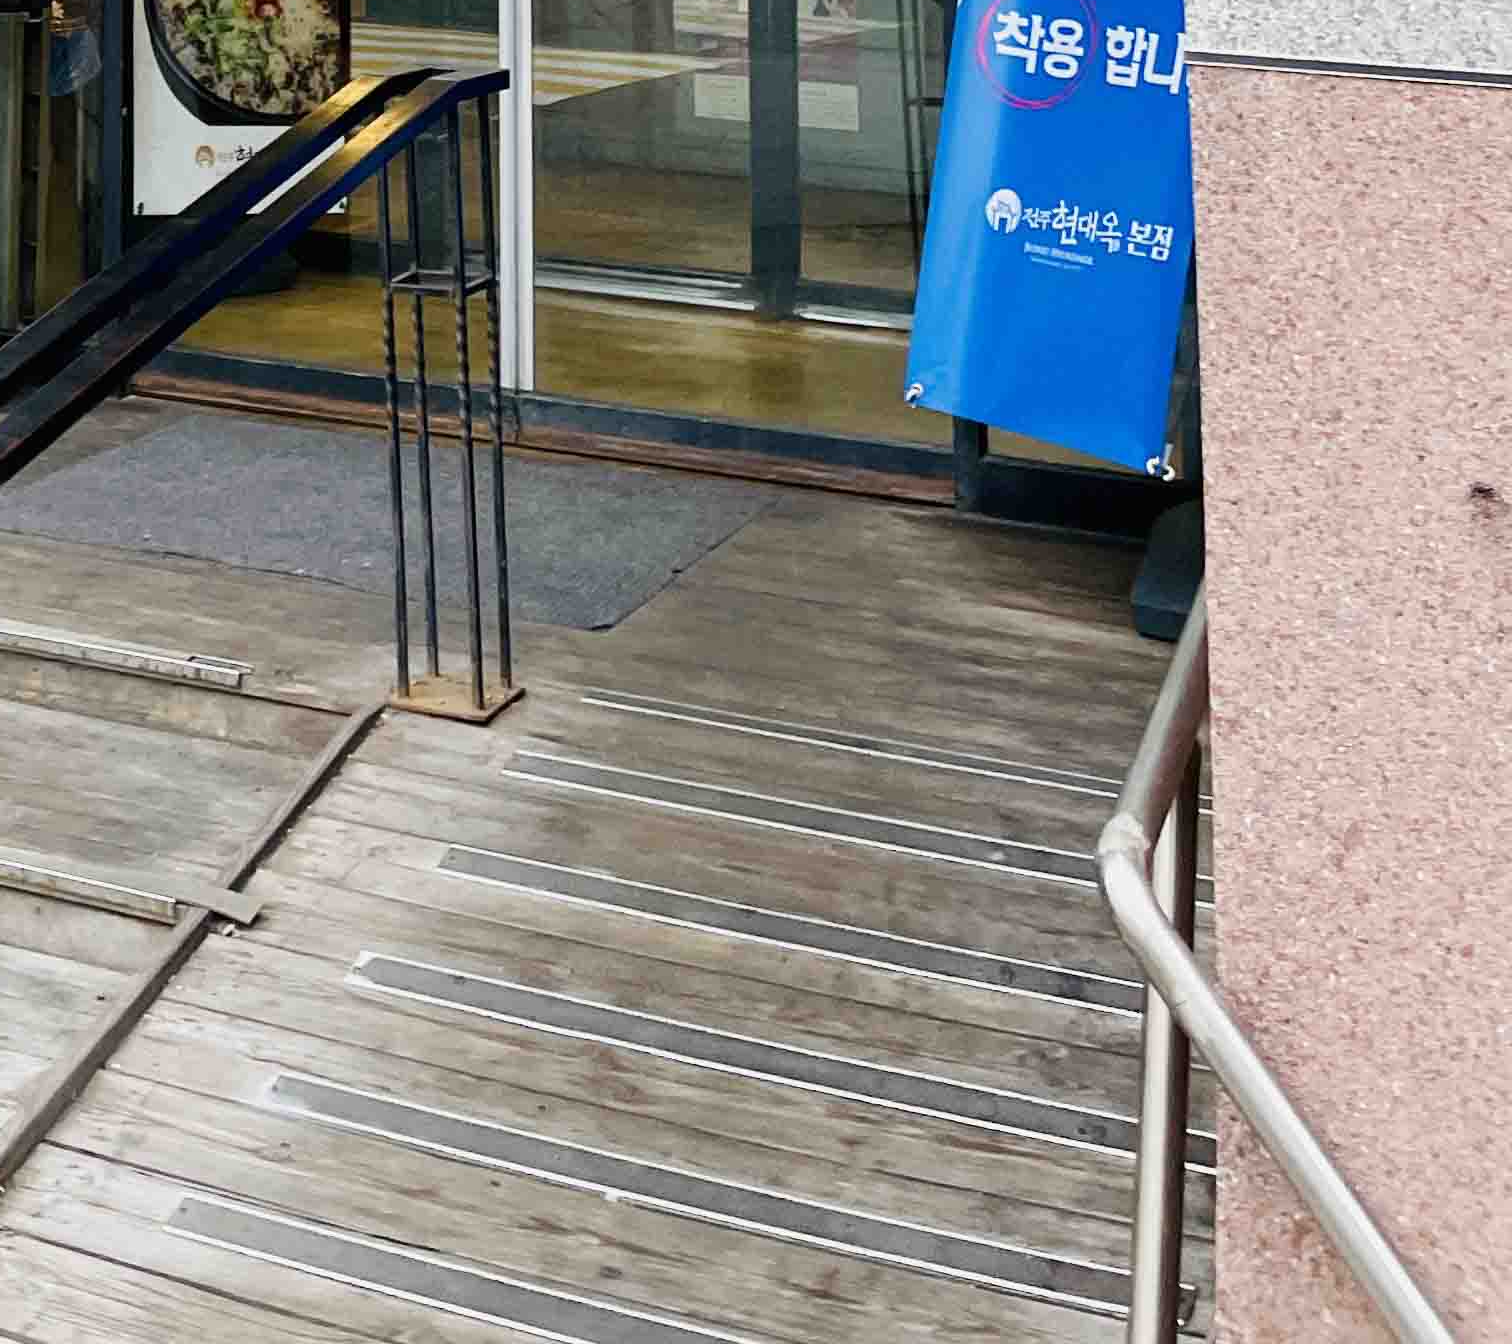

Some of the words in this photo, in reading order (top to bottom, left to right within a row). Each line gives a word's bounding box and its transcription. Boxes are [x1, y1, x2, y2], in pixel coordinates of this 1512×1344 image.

[992, 11, 1085, 79] 착용
[1104, 25, 1190, 95] 합니
[1051, 199, 1123, 254] 현대옥
[1126, 220, 1175, 262] 본점
